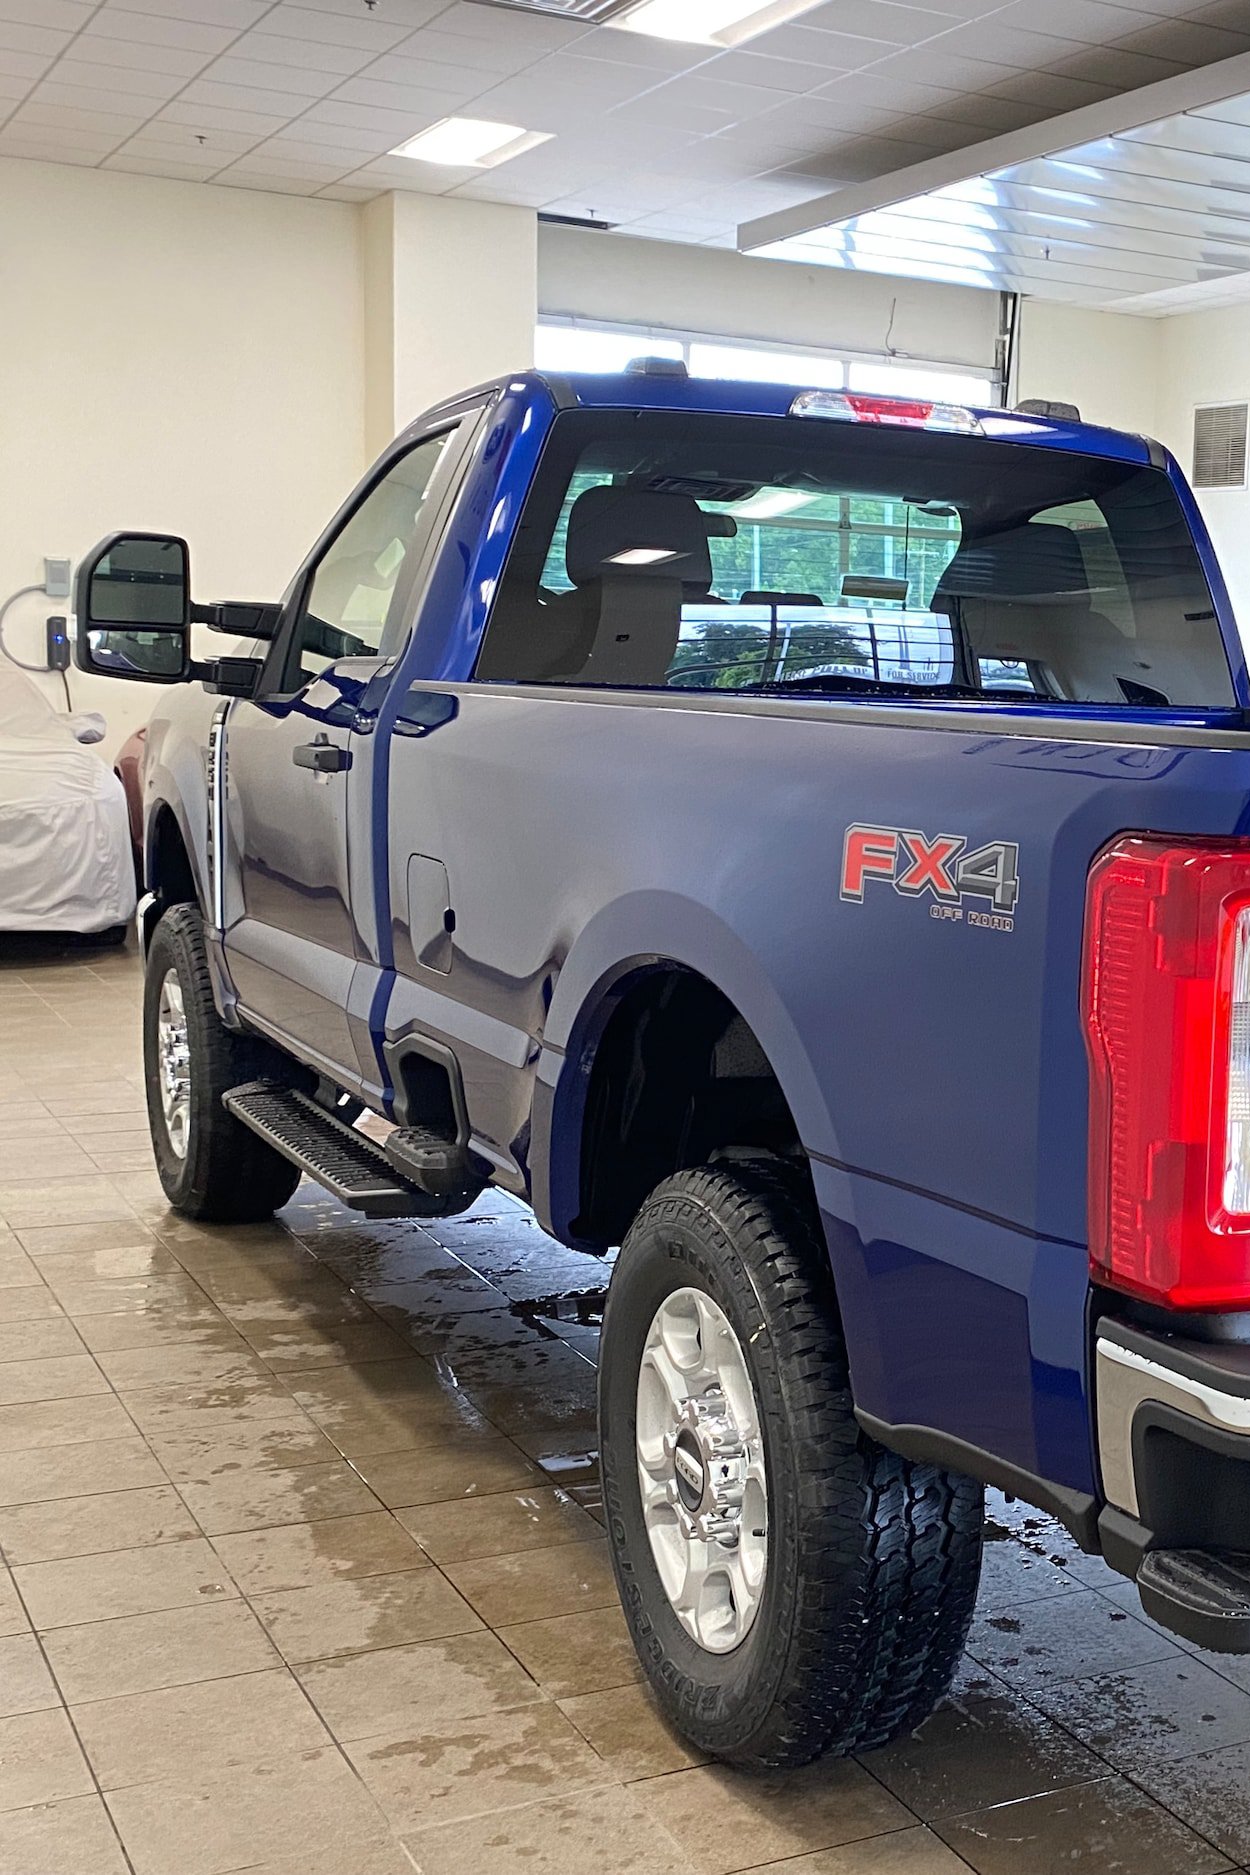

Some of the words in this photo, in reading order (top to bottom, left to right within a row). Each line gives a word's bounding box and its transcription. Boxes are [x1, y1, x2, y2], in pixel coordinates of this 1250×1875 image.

[840, 822, 1020, 915] FX4
[930, 905, 963, 921] OFF
[967, 911, 1014, 932] ROAD
